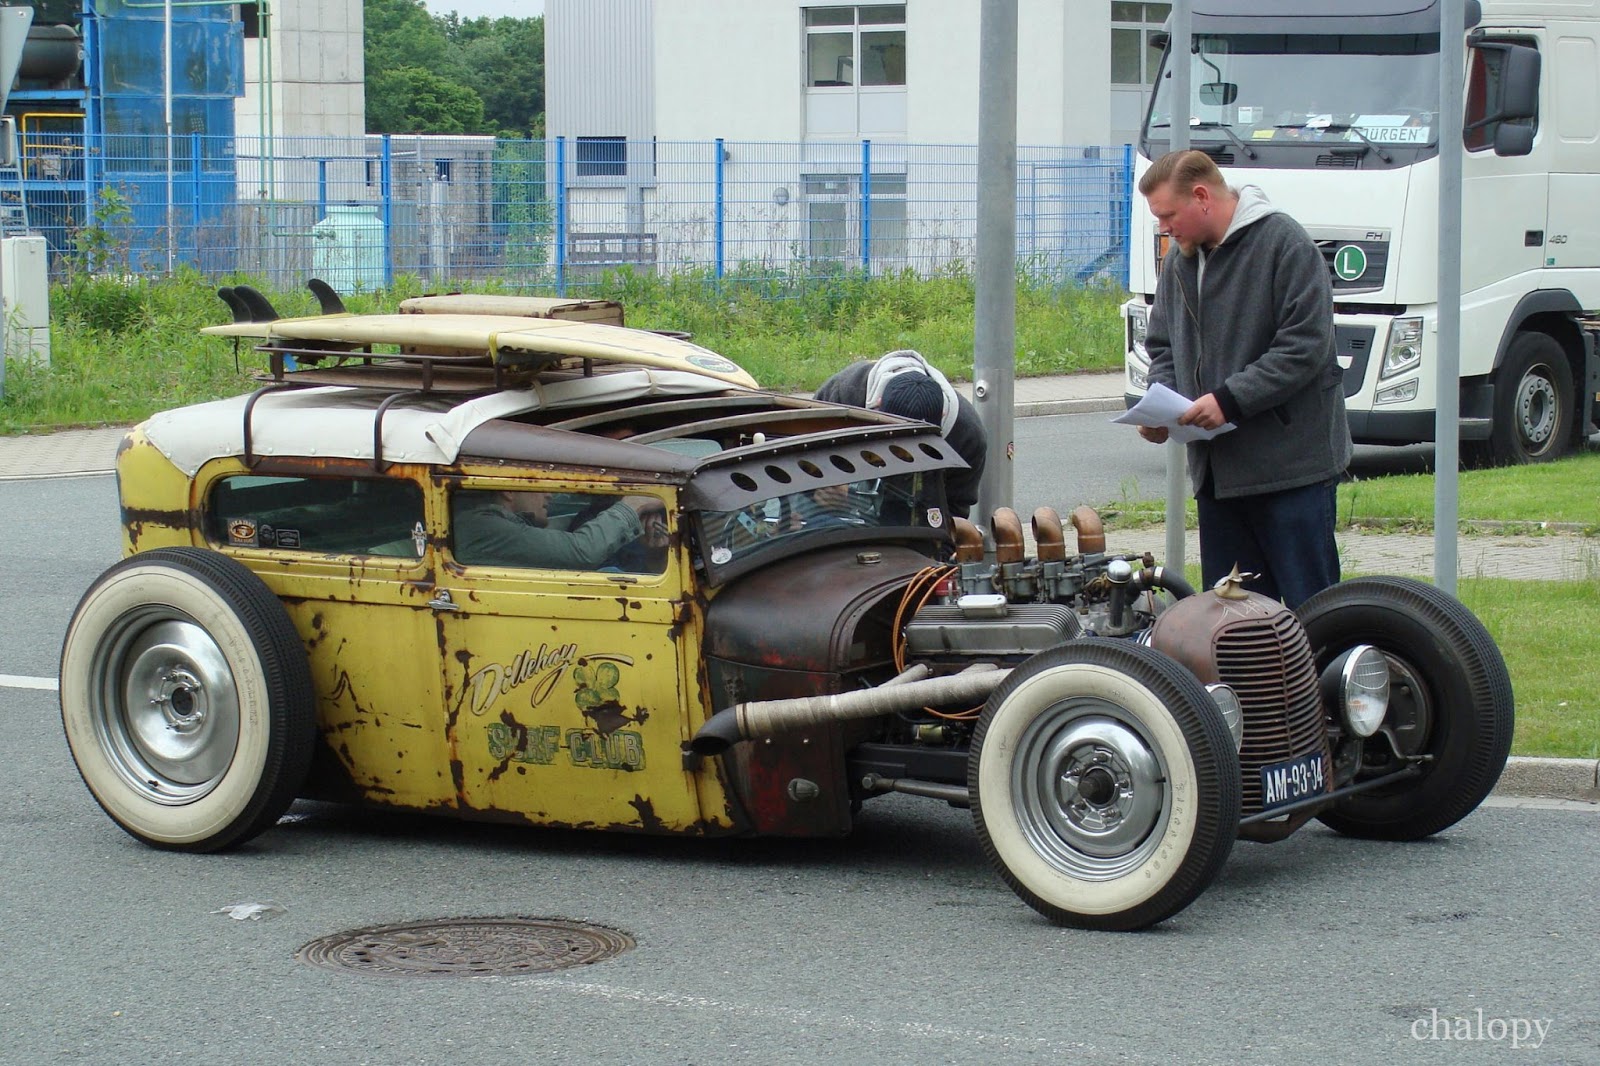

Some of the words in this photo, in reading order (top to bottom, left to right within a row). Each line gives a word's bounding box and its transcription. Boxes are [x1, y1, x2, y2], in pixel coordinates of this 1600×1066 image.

[1365, 231, 1384, 240] FH
[1343, 251, 1357, 274] L
[570, 731, 641, 766] CLUB
[1266, 756, 1324, 804] AM-93-34
